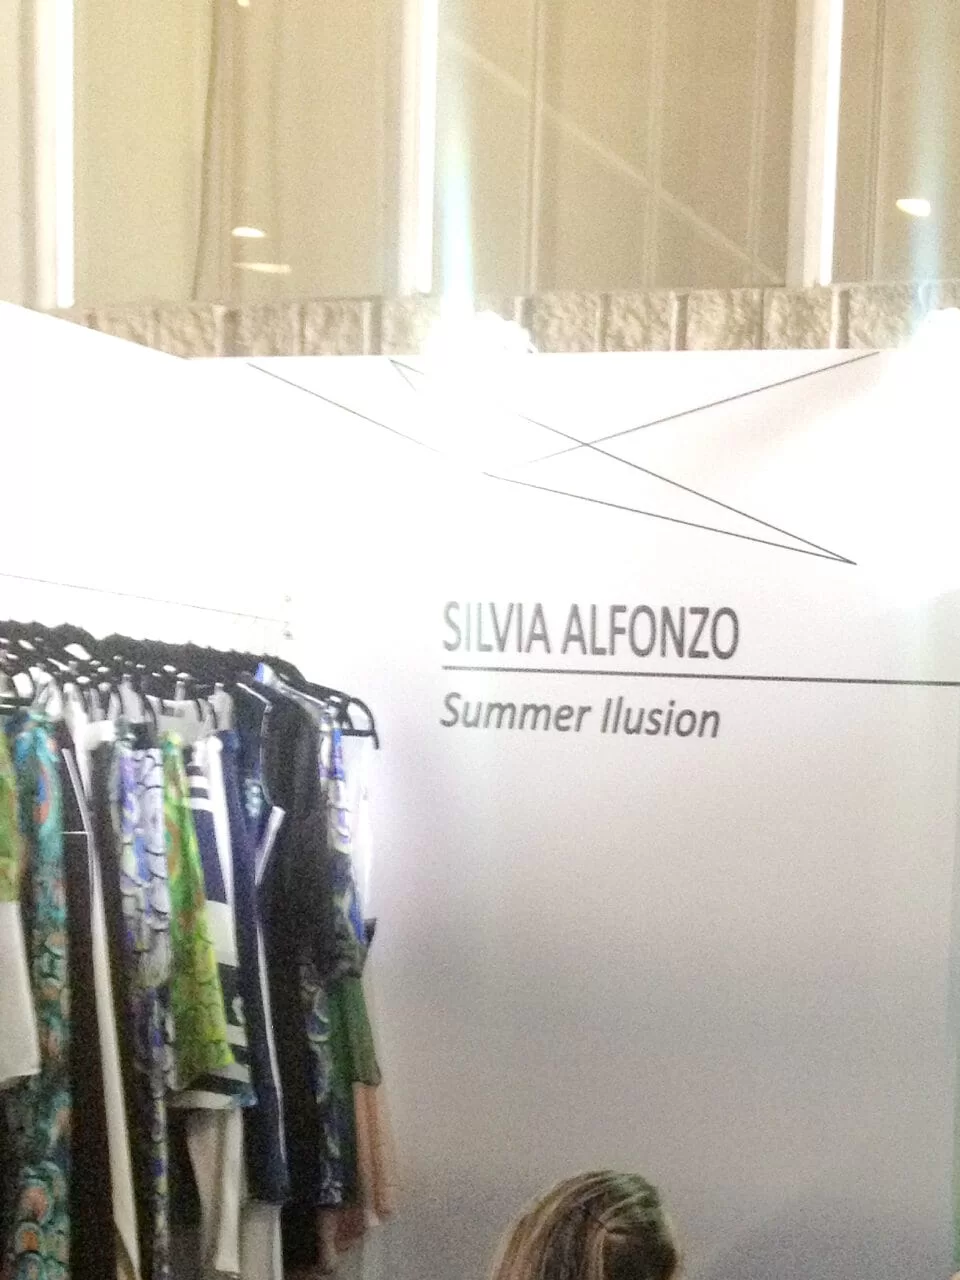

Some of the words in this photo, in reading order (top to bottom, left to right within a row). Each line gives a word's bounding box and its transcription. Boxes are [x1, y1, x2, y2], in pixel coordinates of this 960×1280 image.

[442, 600, 551, 654] SILVIA
[560, 603, 740, 660] ALFONZO
[439, 691, 592, 732] Summer
